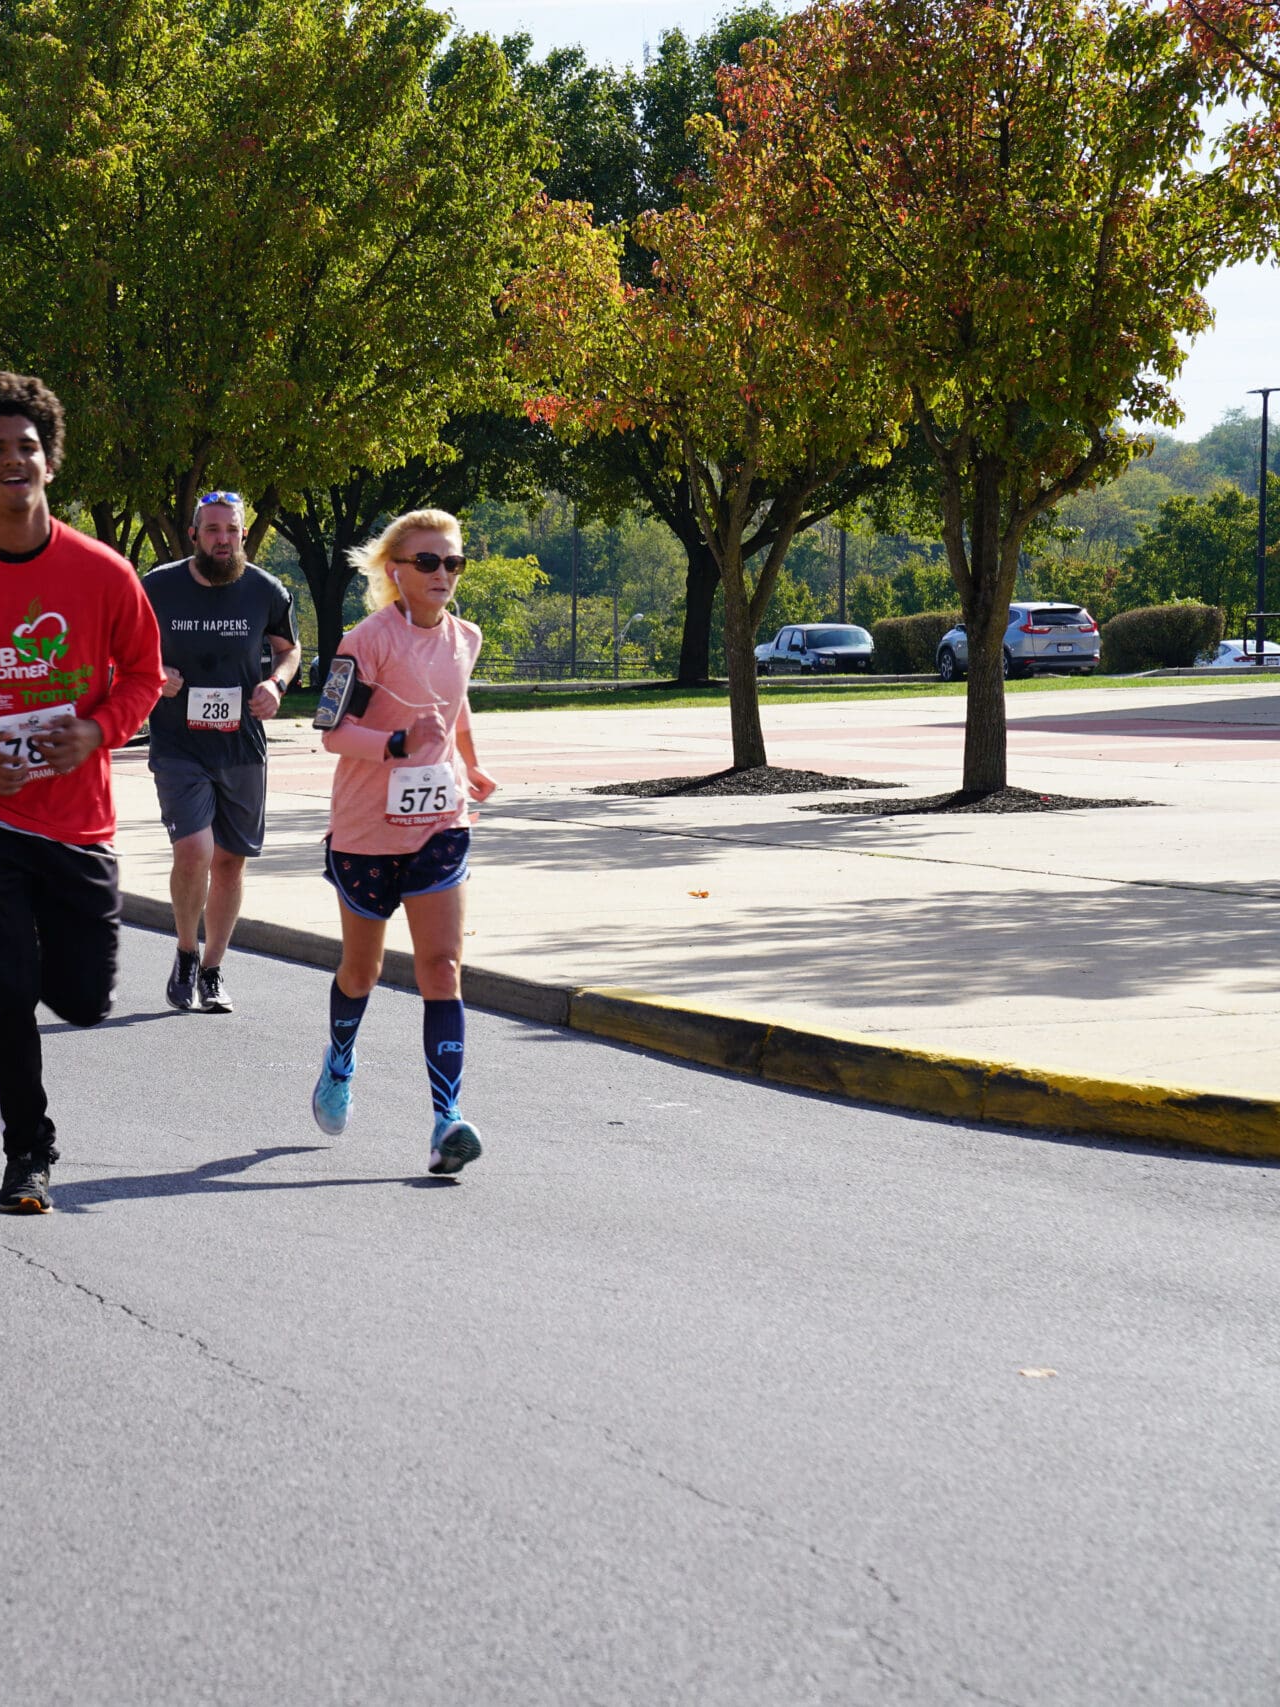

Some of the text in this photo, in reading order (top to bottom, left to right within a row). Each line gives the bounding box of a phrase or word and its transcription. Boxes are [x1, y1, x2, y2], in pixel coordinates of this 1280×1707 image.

[171, 619, 251, 631] SHIRT HAPPENS.
[202, 702, 229, 720] 238
[399, 785, 447, 814] 575
[389, 816, 413, 825] APPLE
